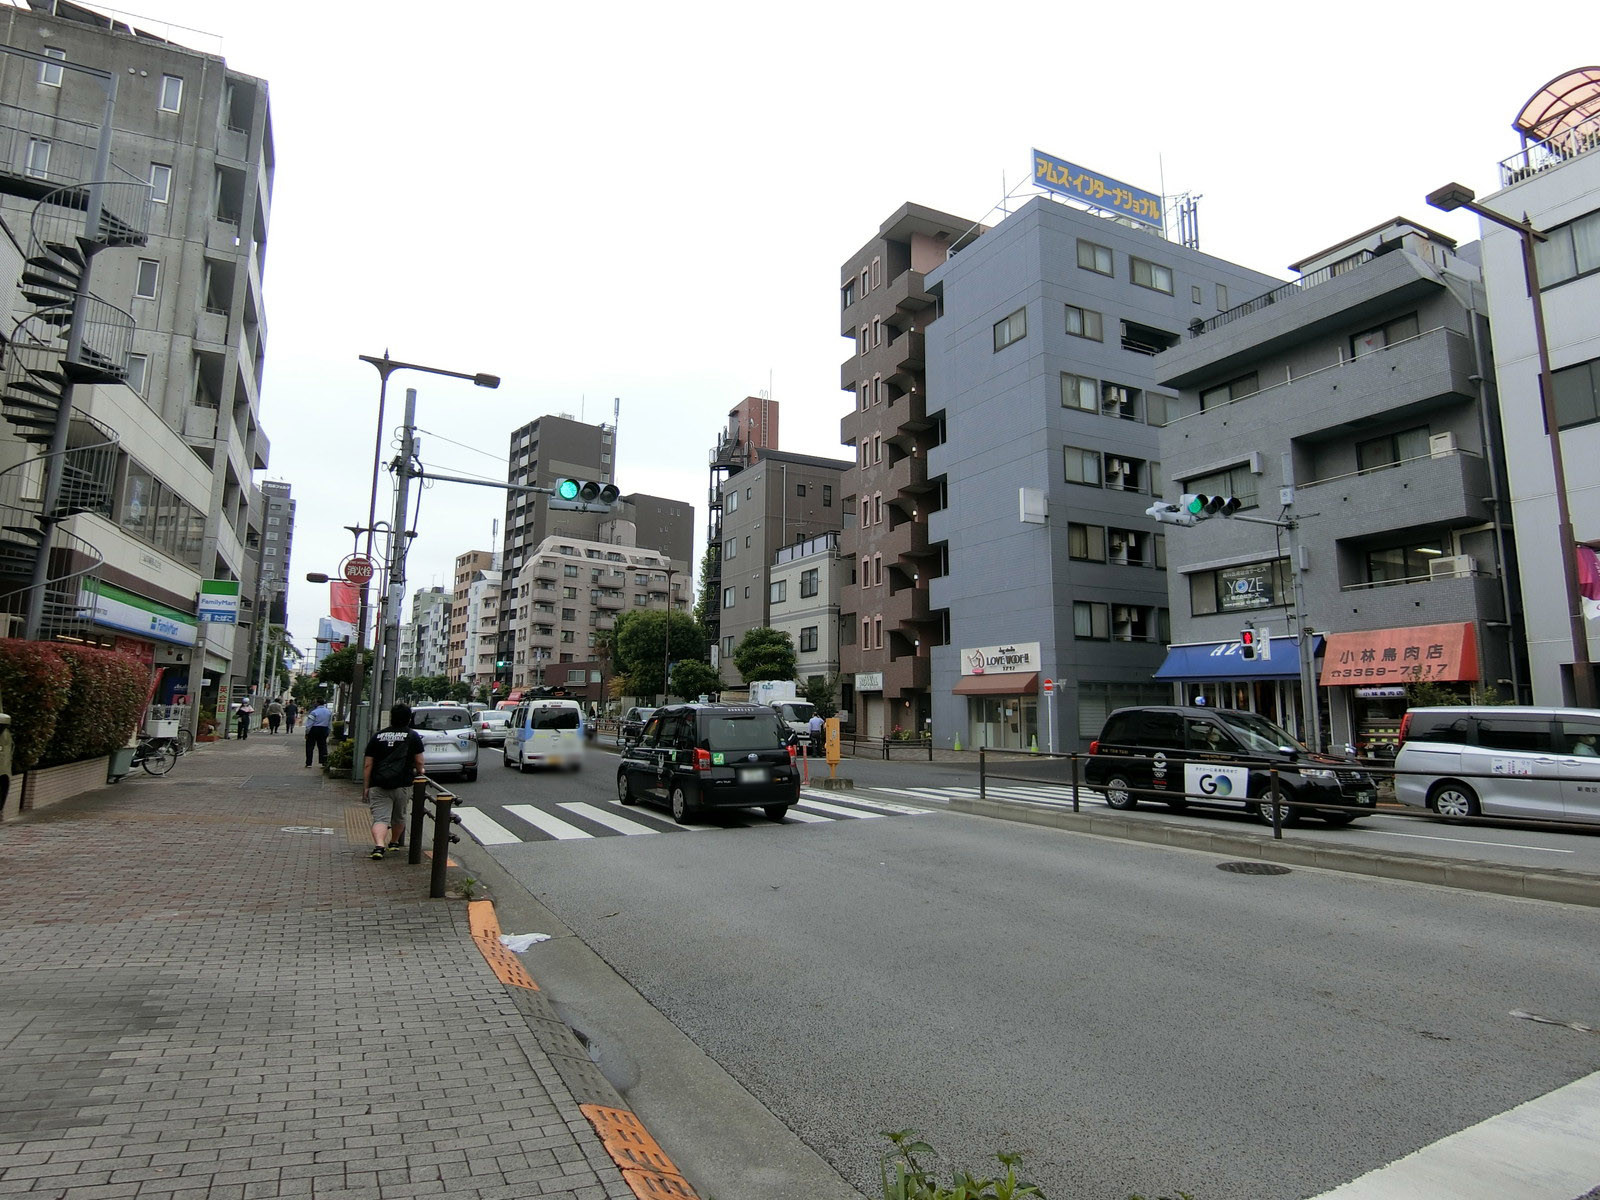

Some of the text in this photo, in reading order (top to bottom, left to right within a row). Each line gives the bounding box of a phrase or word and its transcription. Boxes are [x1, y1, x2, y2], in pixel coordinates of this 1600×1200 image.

[1036, 157, 1160, 219] アムス・インターナショナル
[347, 565, 372, 577] 消火栓
[201, 599, 237, 607] FamilyMart
[202, 614, 233, 622] 酒 たばこ
[158, 618, 179, 637] FamilyMart
[986, 655, 1005, 666] LOVE
[1340, 644, 1444, 664] 小林鳥肉店
[1199, 773, 1233, 796] GO
